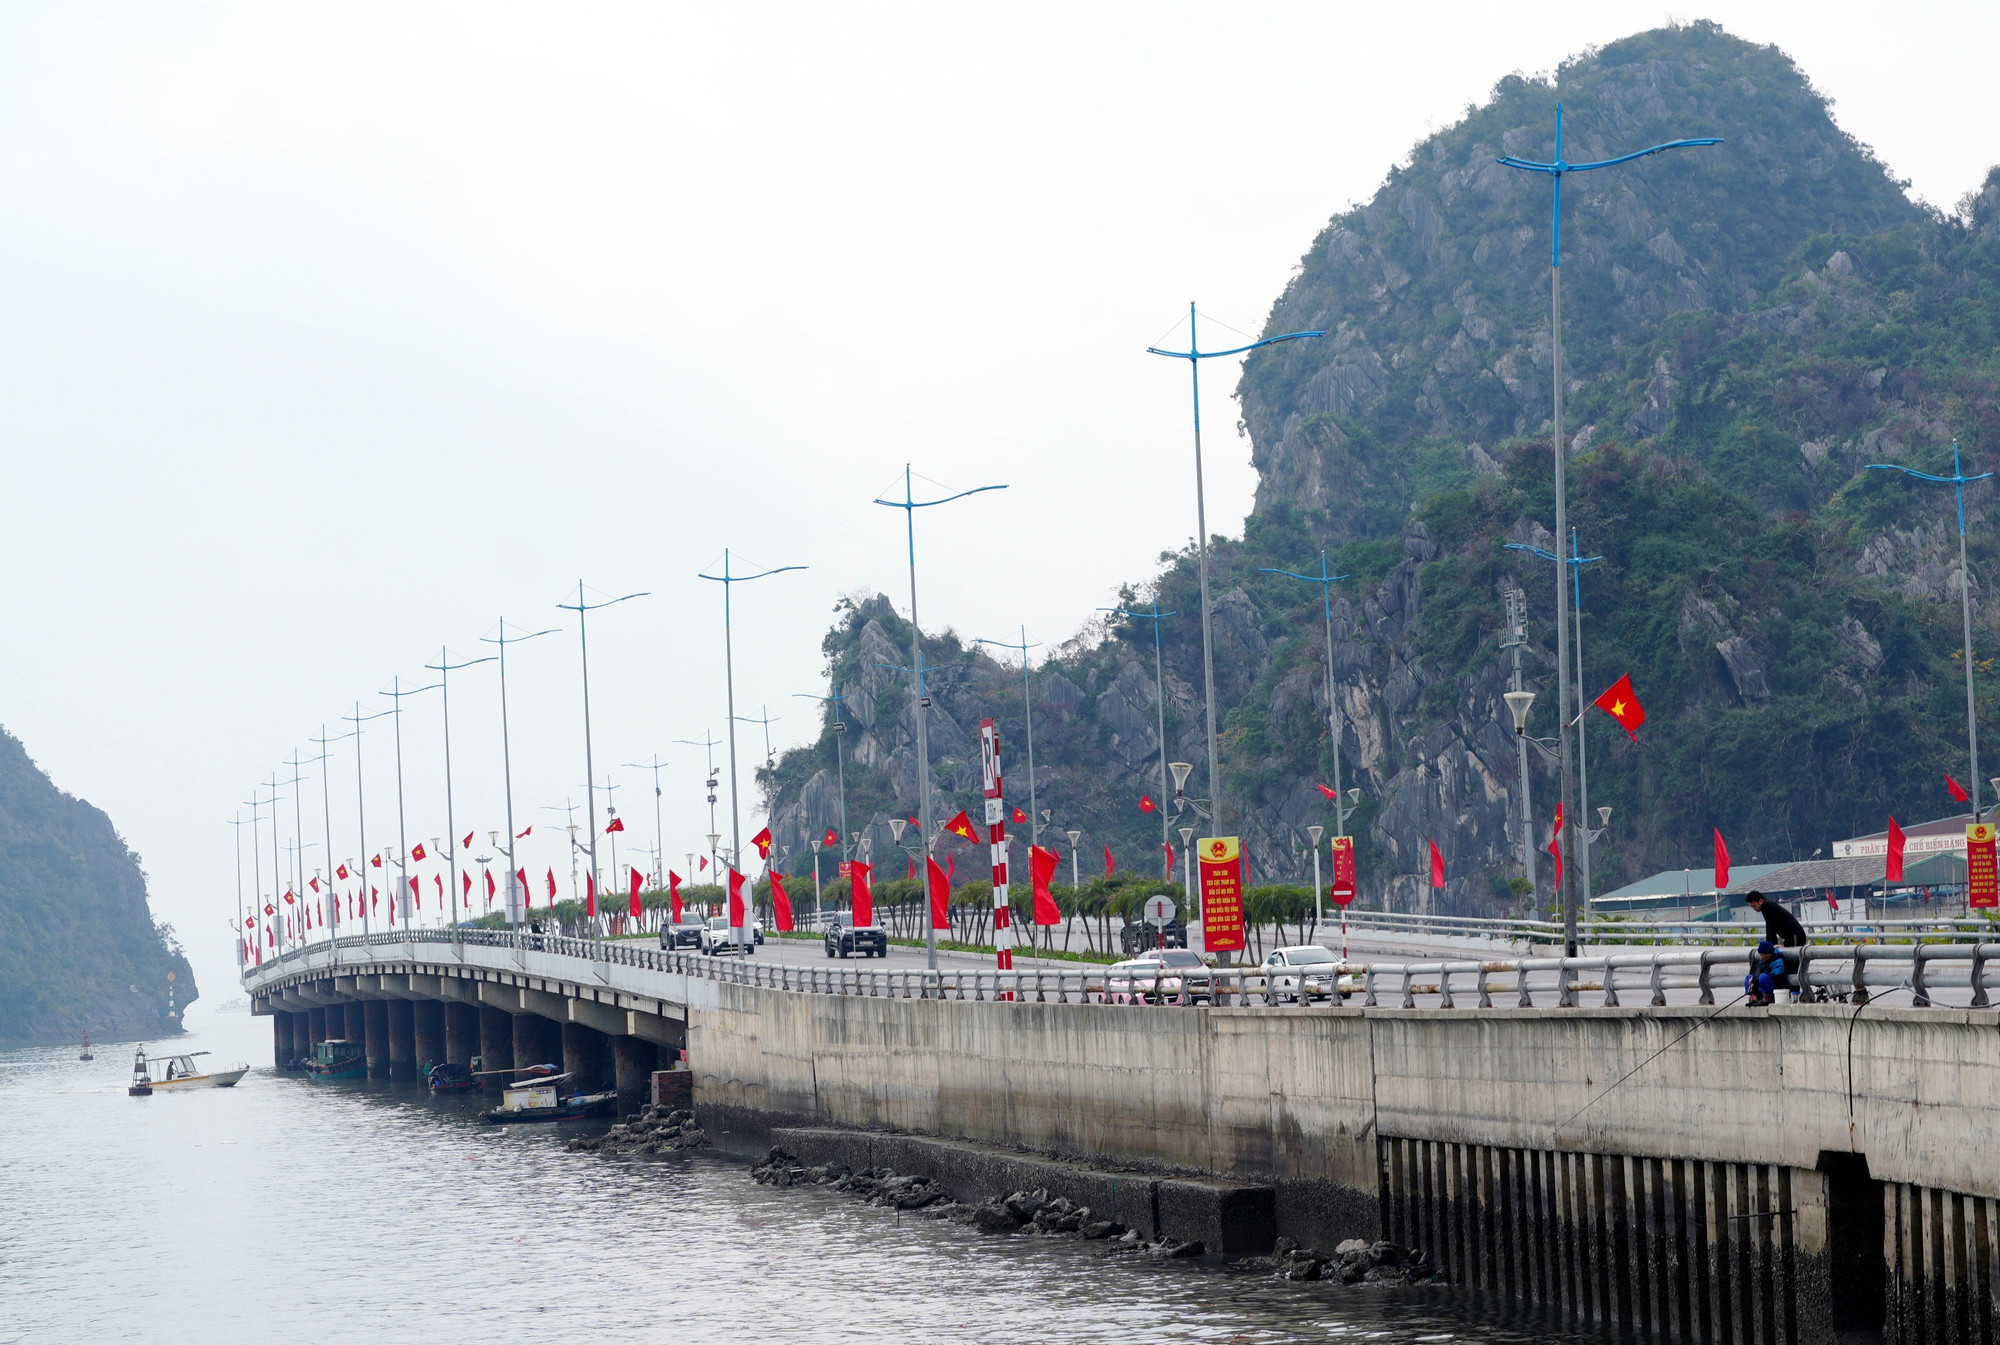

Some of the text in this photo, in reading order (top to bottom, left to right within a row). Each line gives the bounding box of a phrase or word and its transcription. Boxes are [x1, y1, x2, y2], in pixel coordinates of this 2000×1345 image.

[1910, 838, 1924, 850] CHẾ
[1926, 837, 1943, 850] BIẾN
[1944, 837, 1965, 848] HÀNG
